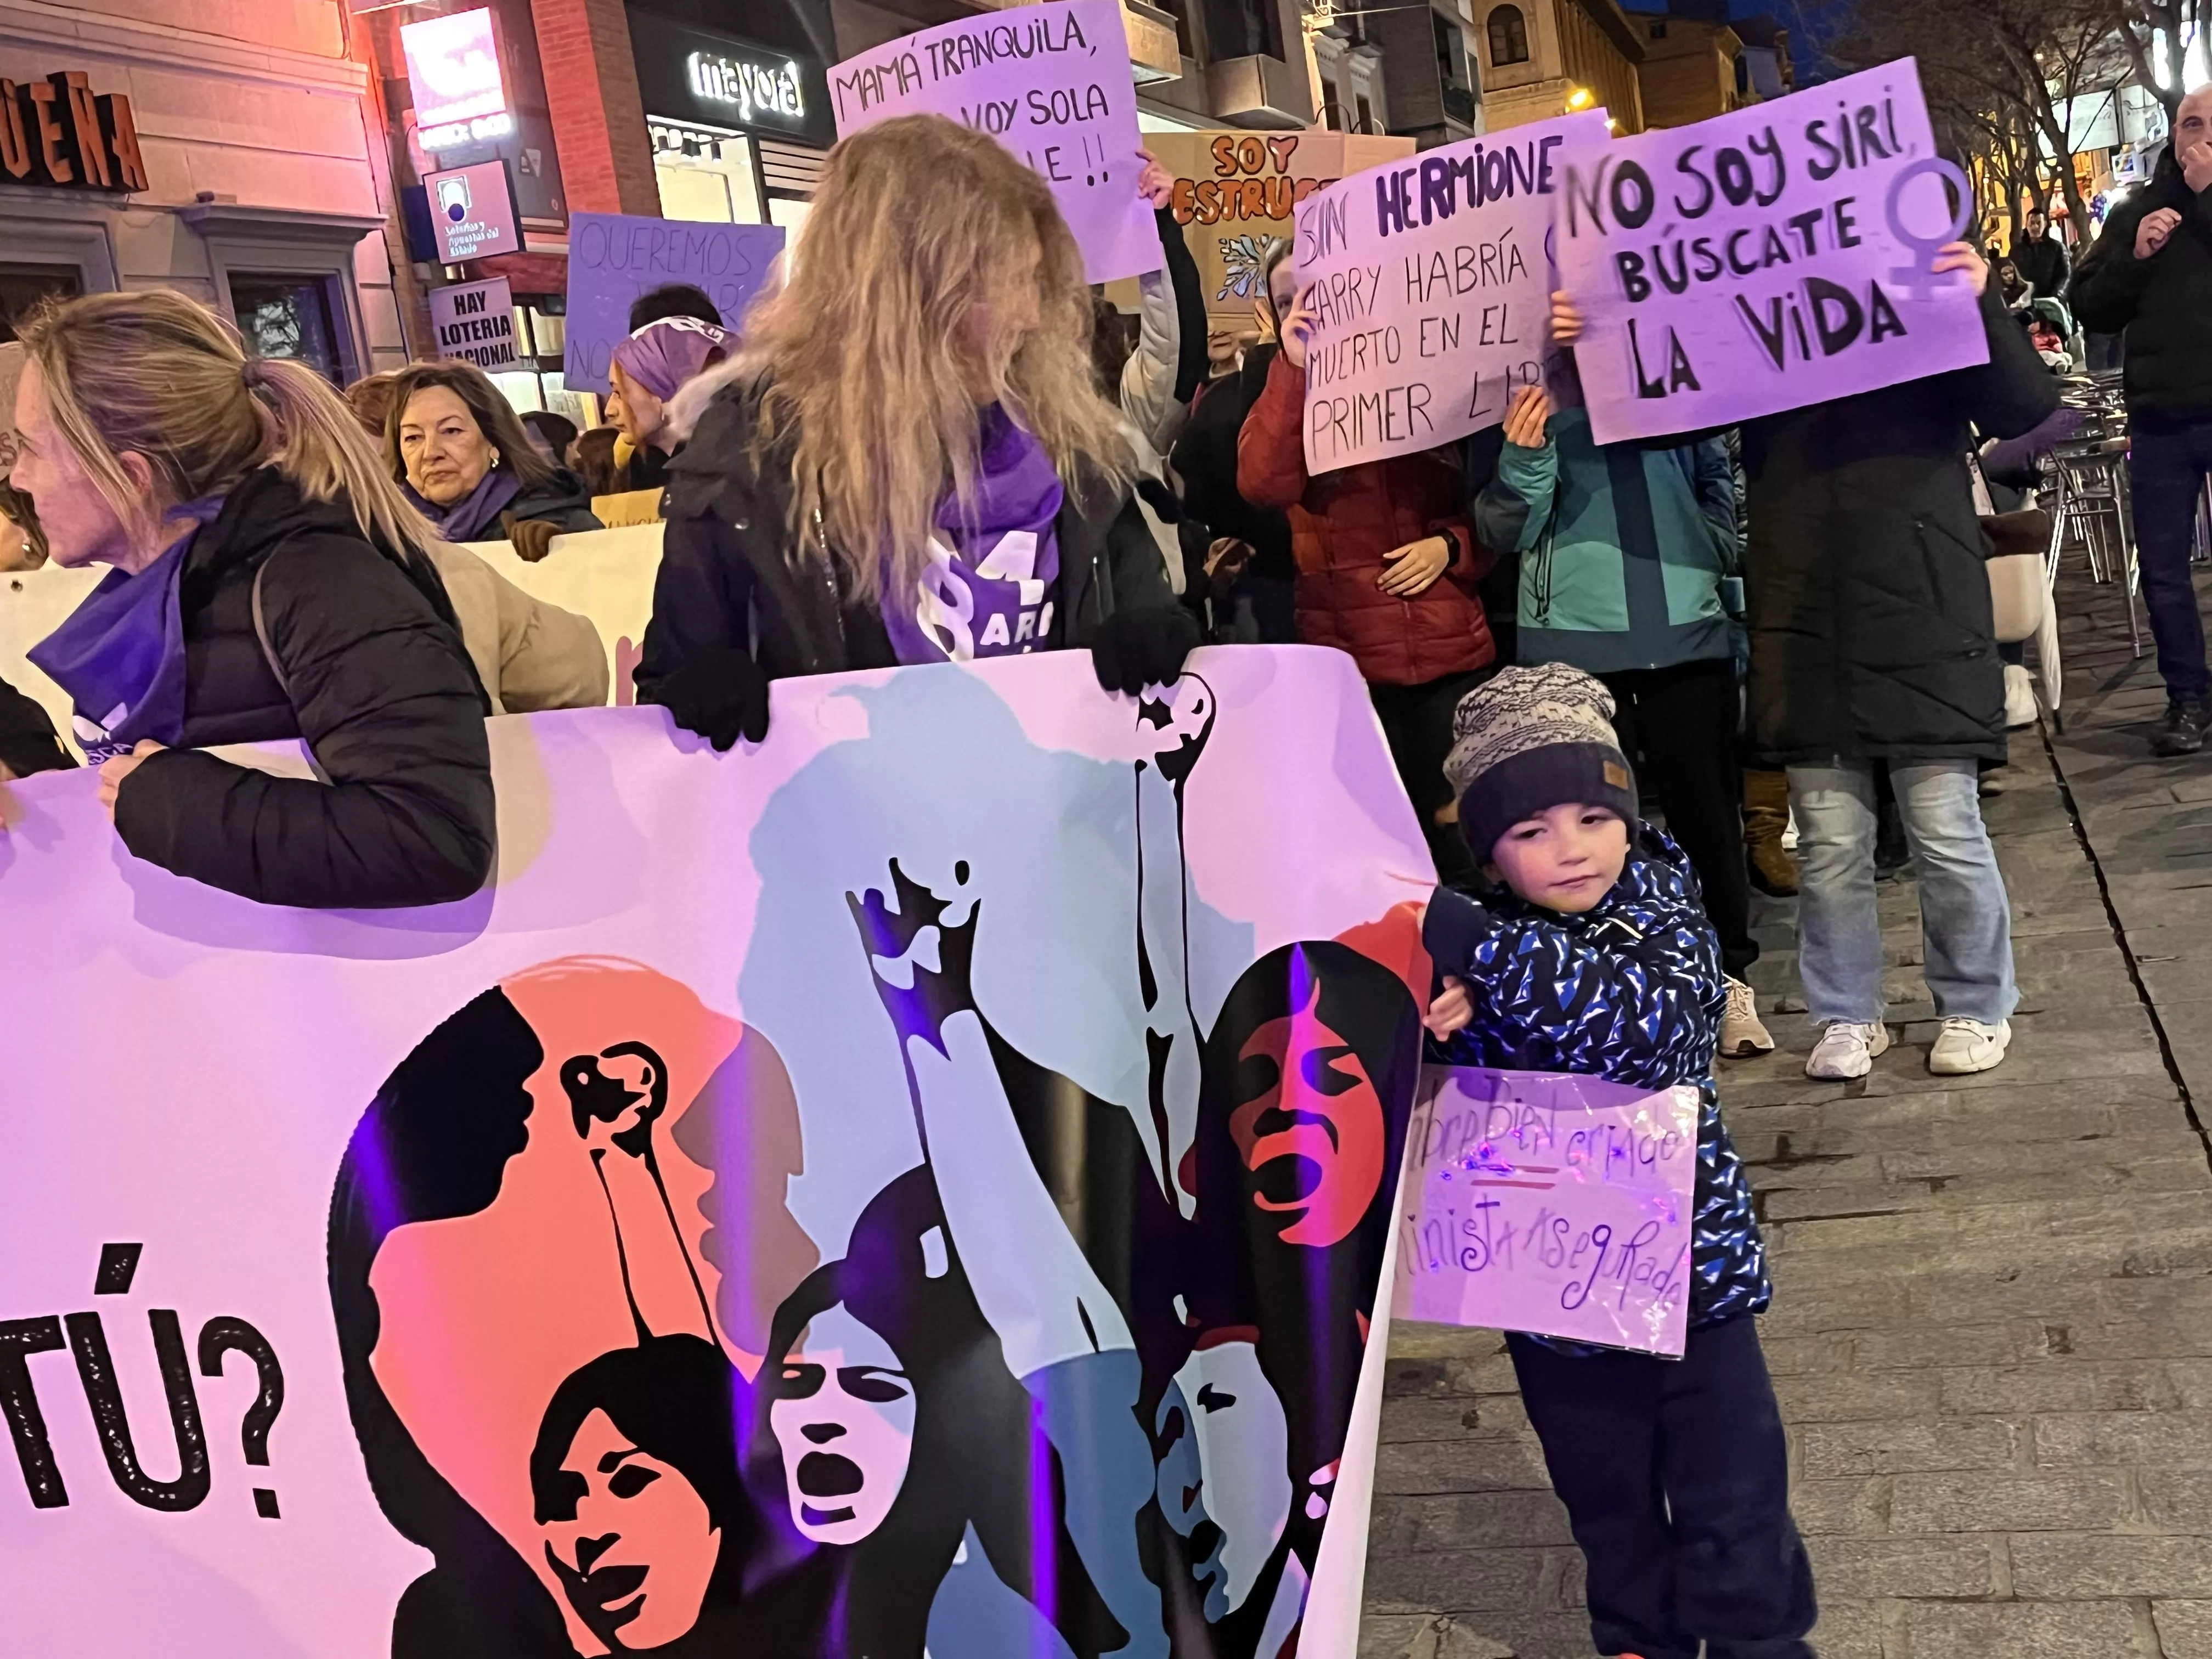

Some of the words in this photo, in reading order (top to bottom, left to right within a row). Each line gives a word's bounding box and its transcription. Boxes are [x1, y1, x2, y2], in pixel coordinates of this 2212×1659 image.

[836, 36, 923, 122] MAMÁ
[961, 98, 1018, 134] VOY
[1026, 84, 1109, 125] SOLA
[1210, 135, 1299, 176] SOY
[1299, 191, 1349, 268] SIN
[1563, 153, 1655, 238] NO
[579, 222, 752, 275] QUEREMOS
[1405, 225, 1528, 305] HABRÍA
[1615, 196, 1862, 302] BÚSCATE
[439, 315, 512, 346] LOTERIA
[454, 291, 486, 315] HAY
[1308, 325, 1401, 390] MUERTO
[1419, 313, 1460, 357] EN
[1479, 303, 1519, 346] EL
[1627, 318, 1701, 399] LA
[1312, 383, 1434, 461] PRIMER
[0, 1243, 285, 1519] TÚ?
